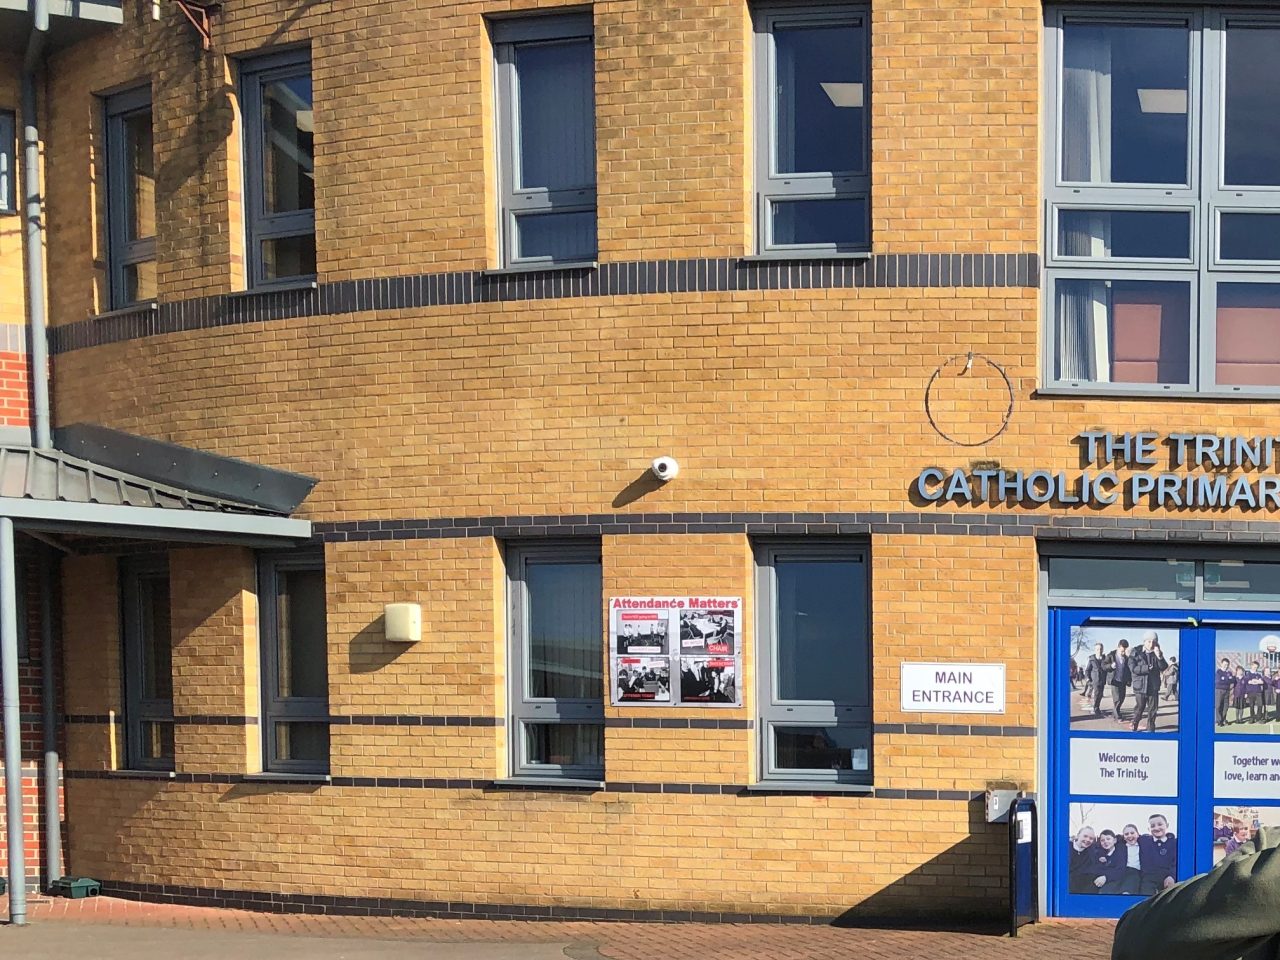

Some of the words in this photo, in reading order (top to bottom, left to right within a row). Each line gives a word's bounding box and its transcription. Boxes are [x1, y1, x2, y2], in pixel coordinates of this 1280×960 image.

[1080, 431, 1158, 464] THE
[918, 467, 1120, 504] CATHOLIC
[613, 597, 685, 609] Attendance
[689, 597, 739, 609] Matters
[935, 671, 973, 685] MAIN
[912, 689, 995, 704] ENTRANCE
[1098, 752, 1139, 764] Welcome
[1140, 753, 1150, 763] to
[1232, 755, 1270, 768] Together
[1100, 767, 1115, 778] The
[1116, 767, 1149, 781] Trinity.
[1224, 770, 1245, 783] love,
[1246, 771, 1268, 781] learn
